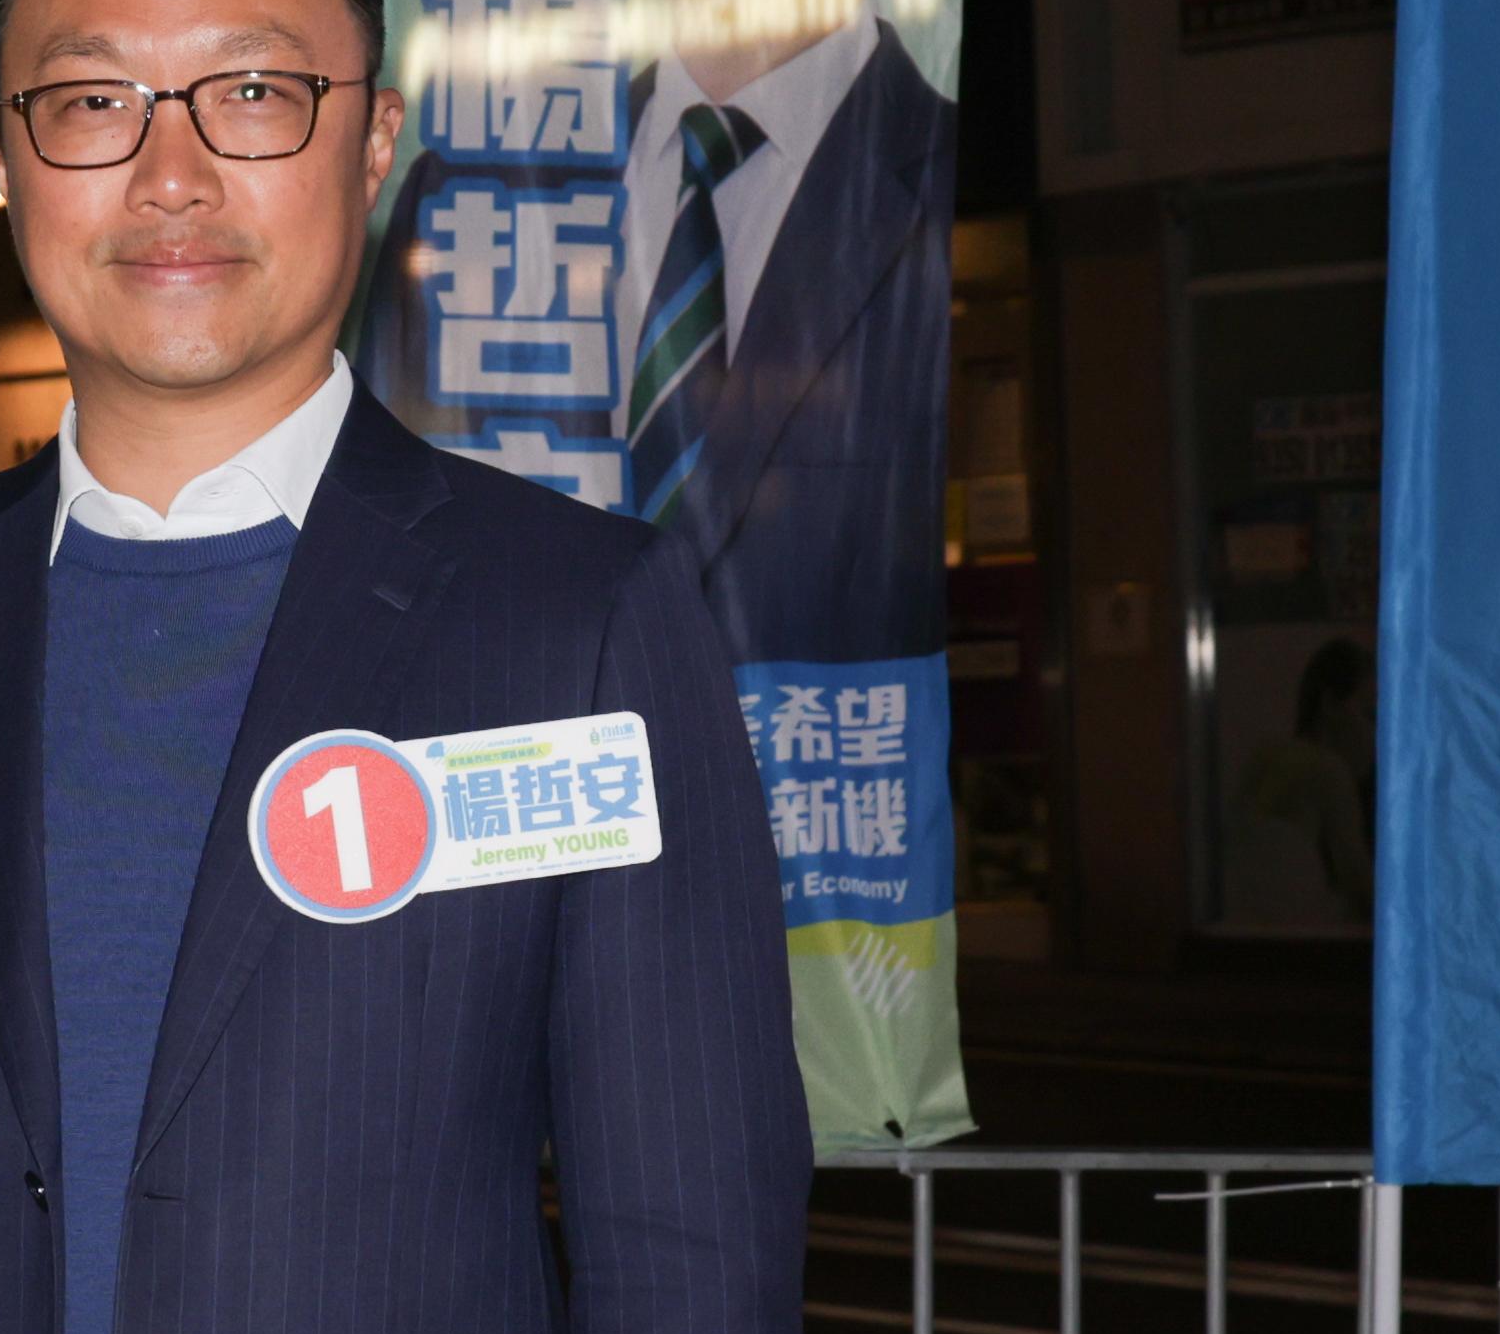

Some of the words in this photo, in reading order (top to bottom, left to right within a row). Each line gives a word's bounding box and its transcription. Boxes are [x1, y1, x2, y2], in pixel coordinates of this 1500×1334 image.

[302, 765, 372, 893] 1
[441, 752, 646, 842] 楊哲安
[471, 841, 546, 867] Jeremy
[553, 828, 630, 855] YOUNG
[803, 871, 908, 904] Economy
